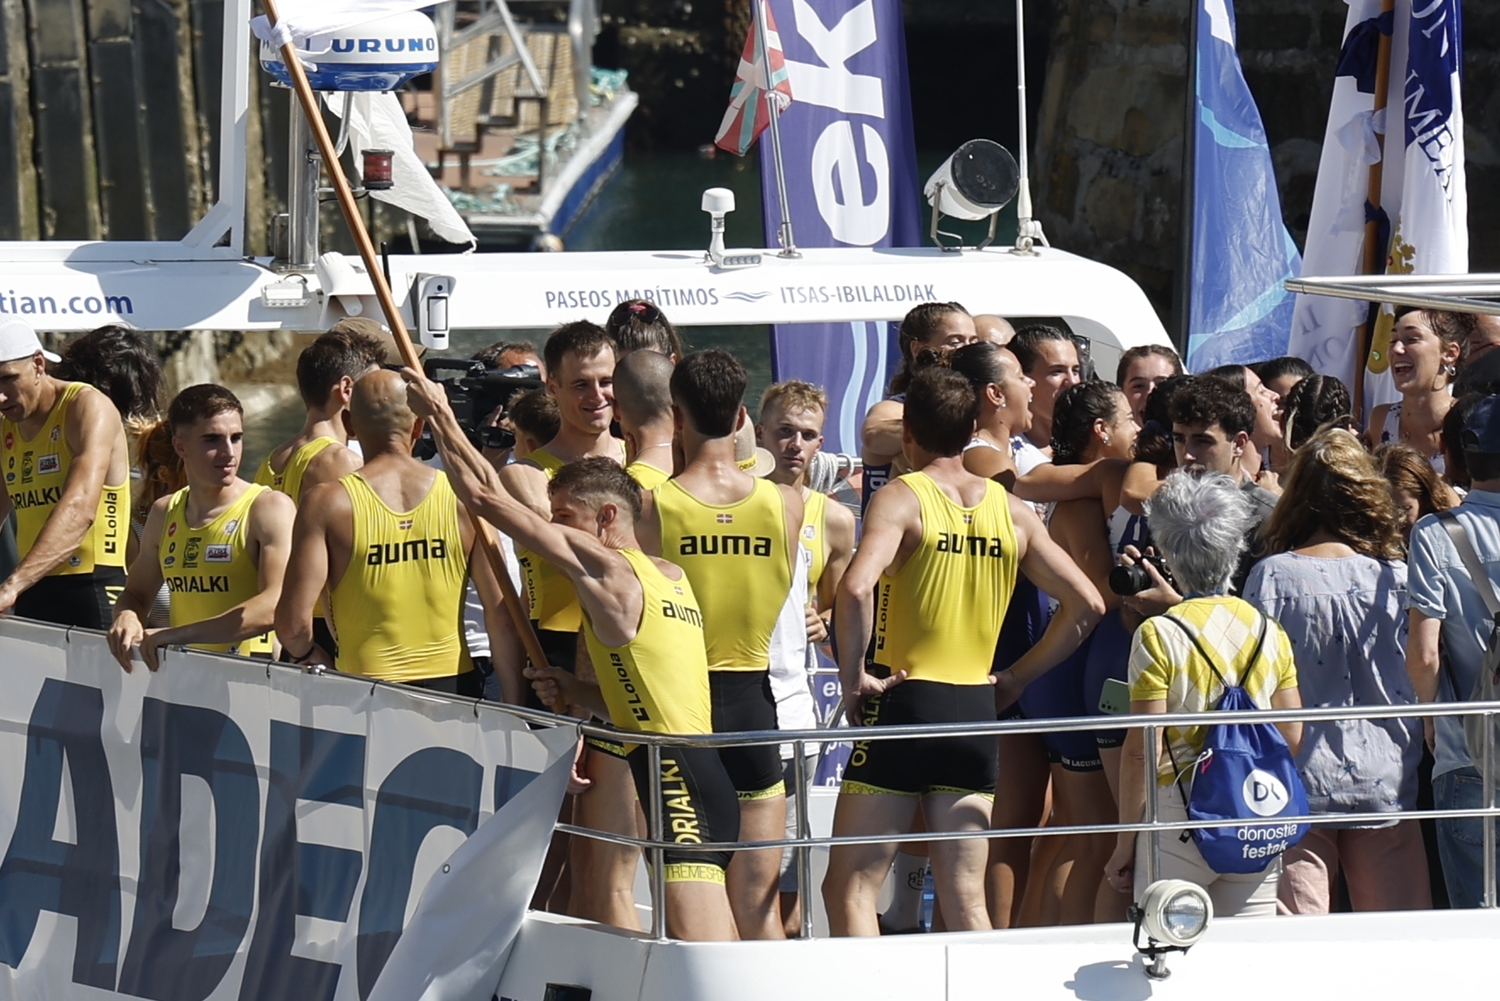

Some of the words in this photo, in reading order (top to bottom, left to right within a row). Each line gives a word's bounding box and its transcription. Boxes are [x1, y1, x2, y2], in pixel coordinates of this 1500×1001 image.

[306, 37, 435, 53] URUNO
[545, 289, 609, 310] PASEOS
[616, 286, 719, 307] MARÍTIMOS
[780, 284, 938, 304] ITSAS-IBILALDIAK
[104, 491, 118, 538] Loiola
[367, 538, 446, 566] auma
[680, 535, 772, 557] auma
[936, 532, 1002, 558] auma
[167, 575, 230, 593] ORIALKI
[878, 583, 891, 633] Loiola
[609, 652, 641, 704] Loiola
[661, 759, 702, 844] ORIALKI
[1237, 823, 1297, 841] donostia
[1242, 840, 1289, 859] festak
